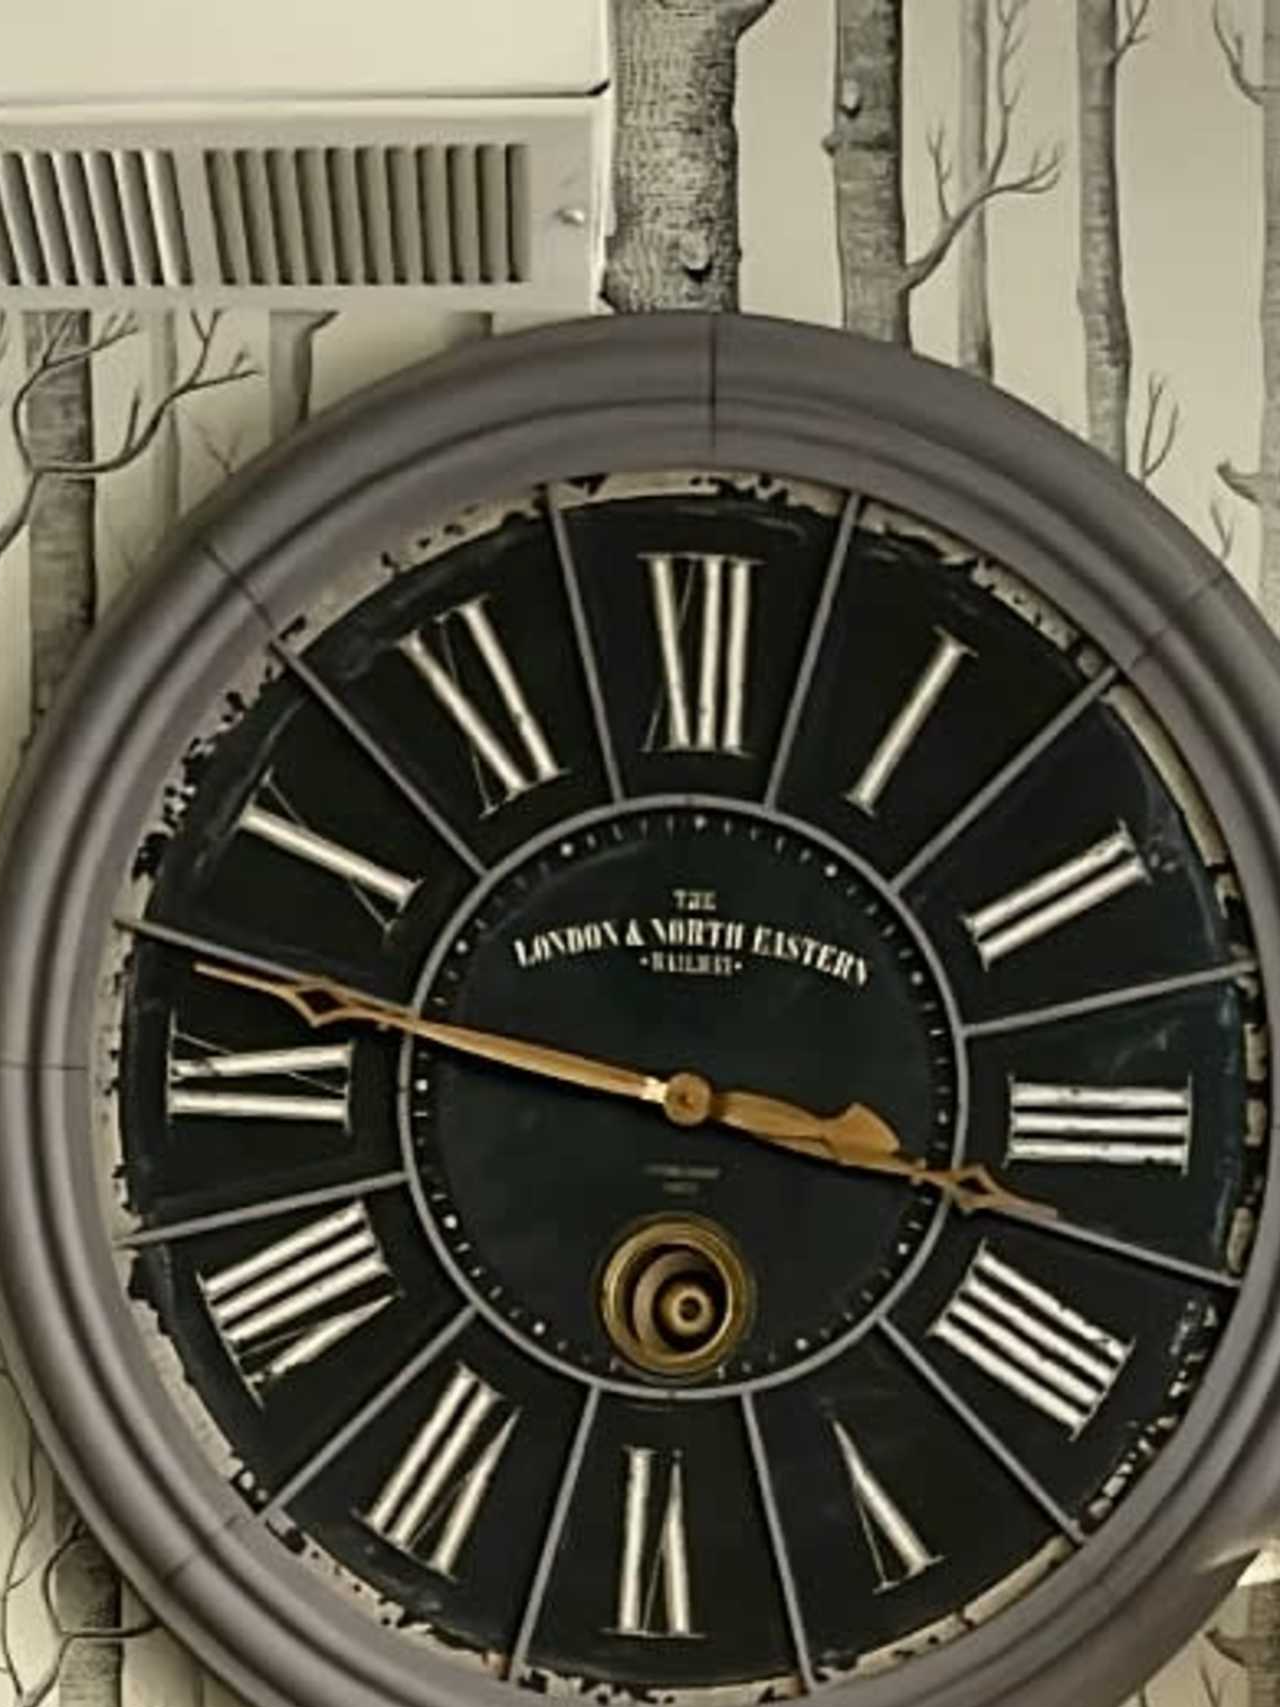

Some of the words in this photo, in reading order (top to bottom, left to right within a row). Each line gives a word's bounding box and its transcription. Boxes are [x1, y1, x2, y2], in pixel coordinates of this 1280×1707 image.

[636, 552, 764, 757] XII
[671, 888, 716, 911] THE
[513, 920, 620, 969] LONDON
[625, 918, 646, 946] &
[651, 917, 744, 951] NORTH
[753, 924, 869, 987] EASTERN
